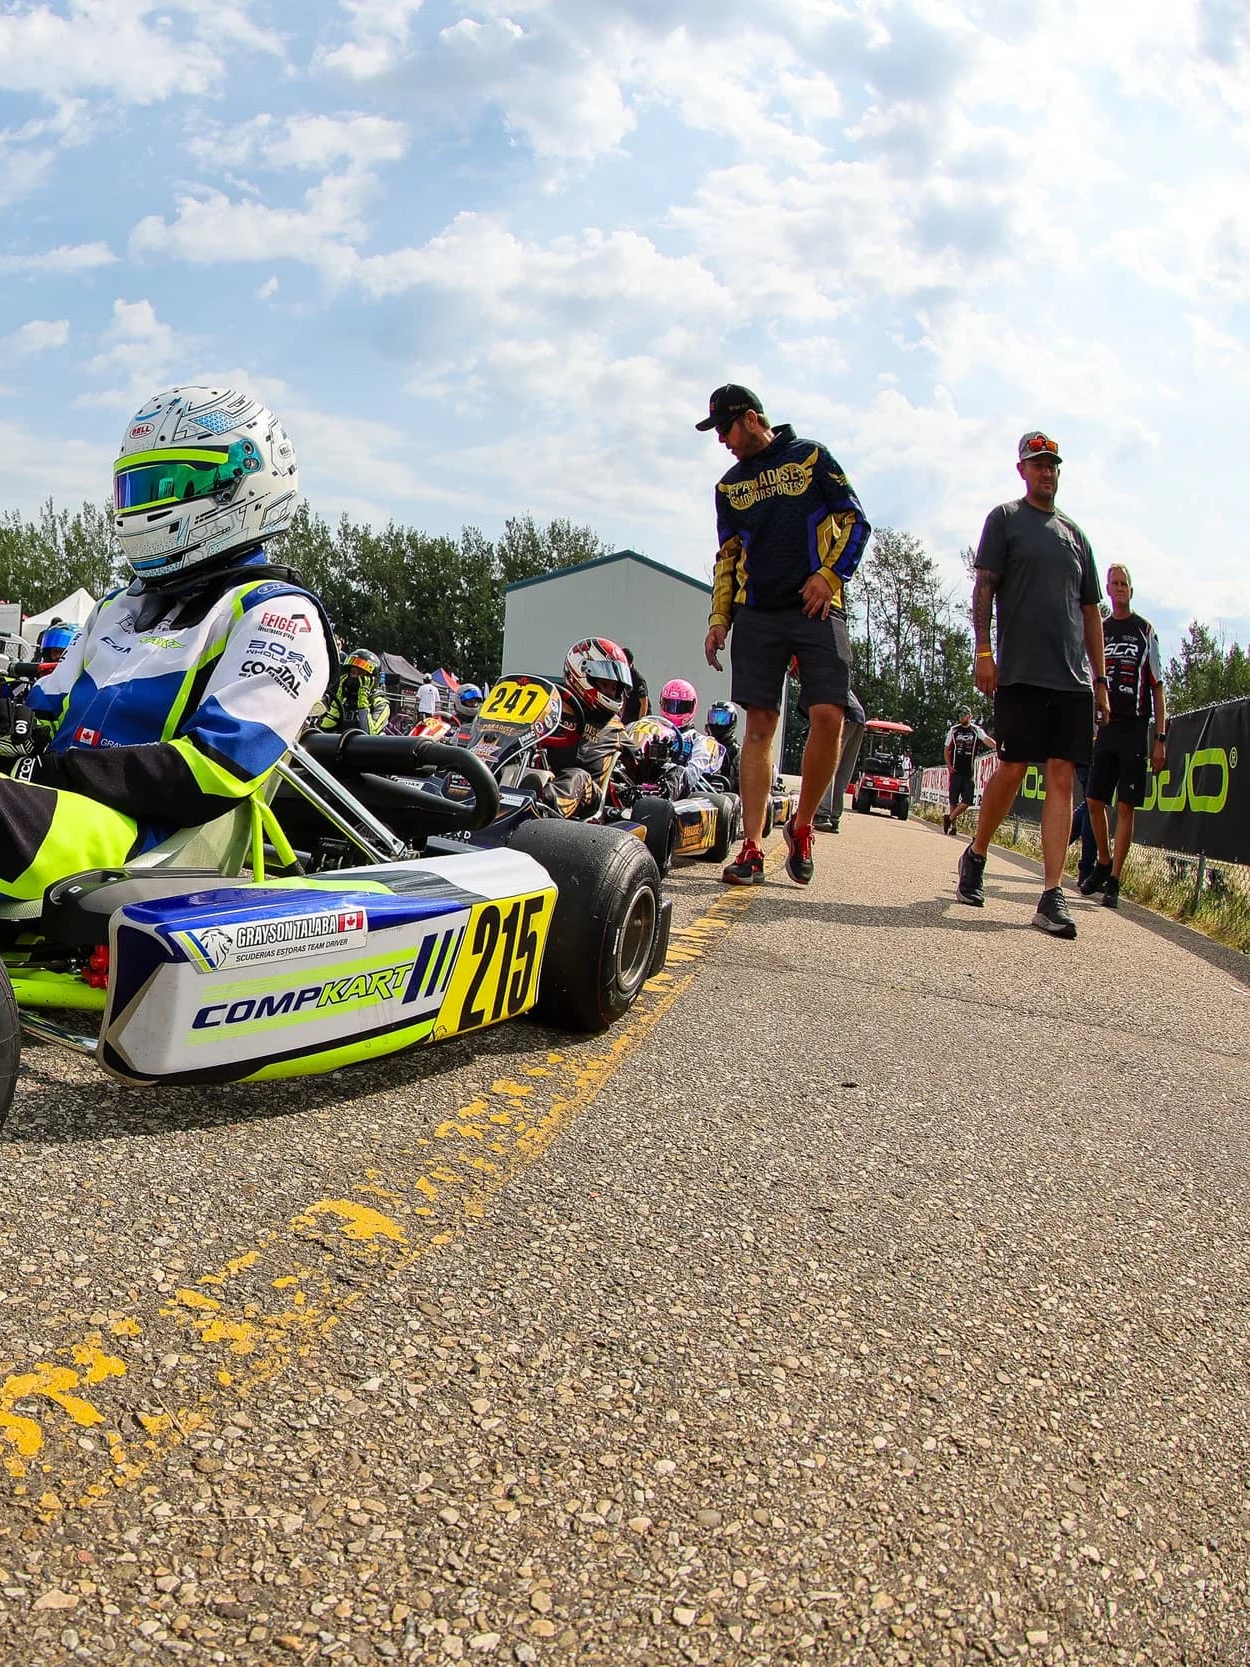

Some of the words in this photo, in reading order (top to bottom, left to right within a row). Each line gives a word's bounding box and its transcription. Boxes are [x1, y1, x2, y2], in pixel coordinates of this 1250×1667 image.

[260, 612, 298, 635] FEIGEL
[487, 687, 538, 717] 247
[236, 921, 295, 949] GRAYSON
[295, 914, 338, 941] TALABA
[235, 949, 276, 963] SCUDERIAS
[276, 944, 307, 958] ESTORAS
[307, 940, 325, 951] TEAM
[325, 938, 349, 949] DRIVER
[456, 895, 545, 1032] 215
[191, 962, 415, 1030] COMPKART
